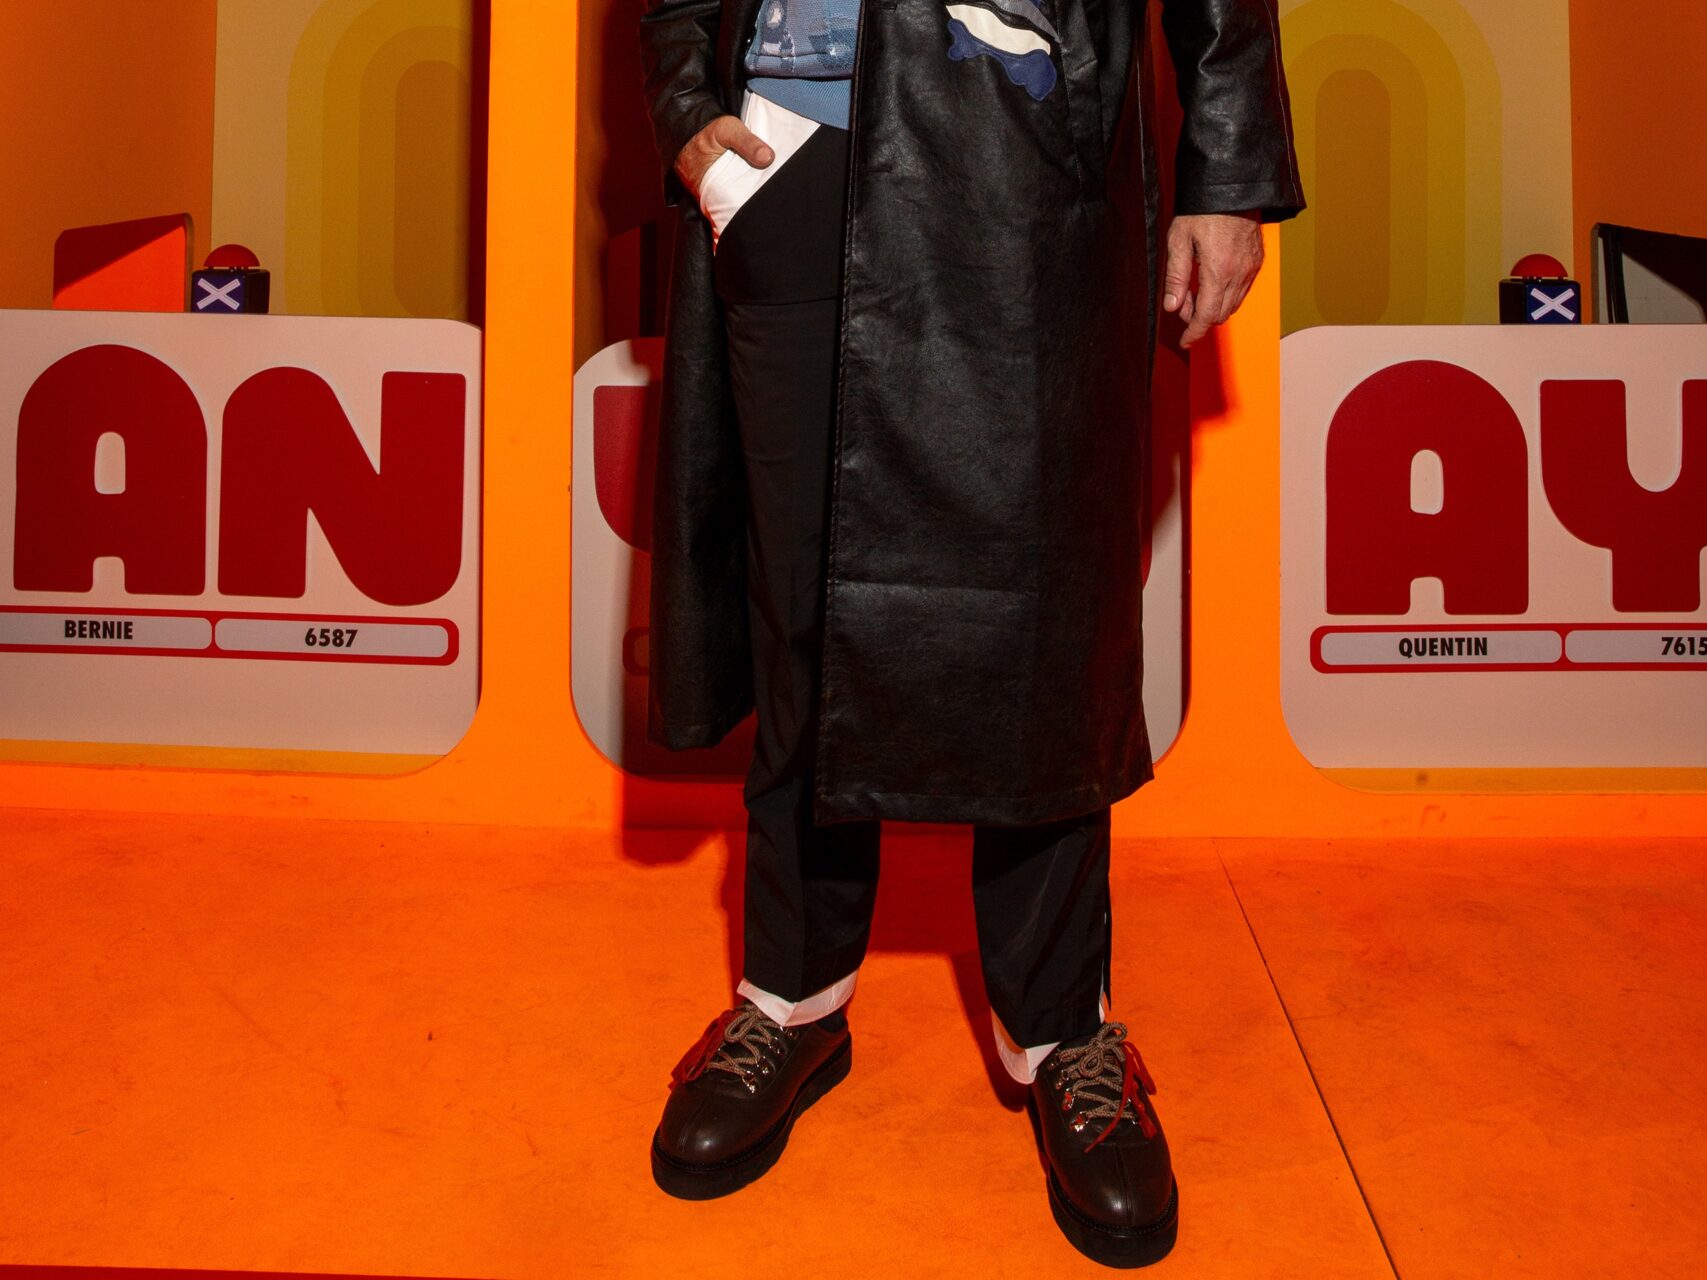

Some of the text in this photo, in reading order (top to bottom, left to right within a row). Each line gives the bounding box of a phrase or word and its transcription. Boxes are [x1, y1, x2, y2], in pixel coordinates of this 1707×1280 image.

[13, 344, 467, 607] AN
[1326, 359, 1707, 615] AY
[64, 619, 358, 648] BERNIE 6587
[1398, 636, 1707, 658] QUENTIN 7615
